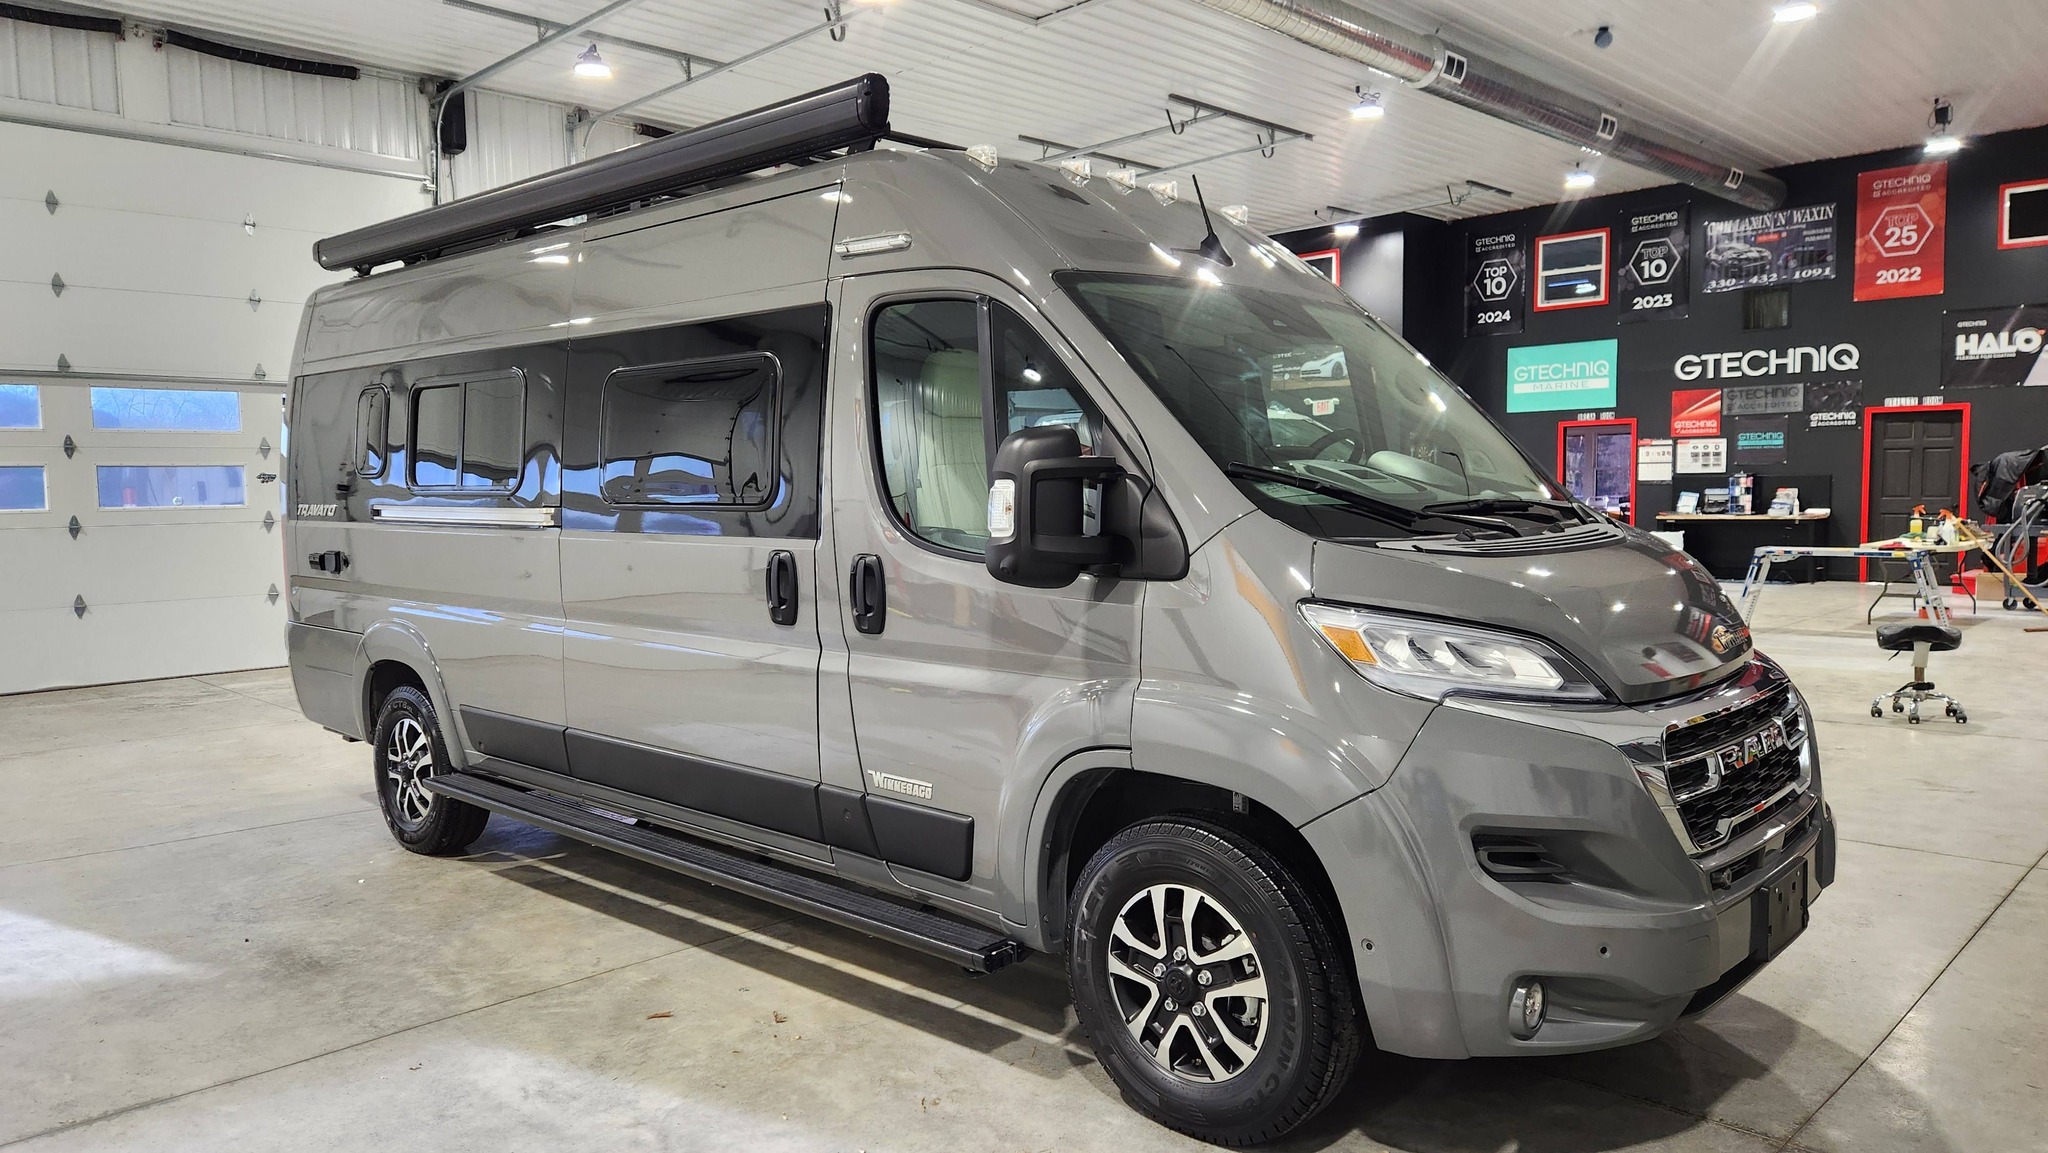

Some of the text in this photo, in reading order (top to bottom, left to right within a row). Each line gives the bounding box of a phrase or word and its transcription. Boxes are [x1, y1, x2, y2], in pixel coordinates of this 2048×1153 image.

[1873, 173, 1931, 190] GTECHNIQ
[1631, 210, 1678, 226] GTECHNIQ
[1793, 203, 1836, 223] WAXIN
[1885, 213, 1919, 228] TOP
[1475, 233, 1516, 247] GTECHNIQ
[1884, 225, 1918, 249] 25
[1481, 242, 1516, 252] ACCREDITED
[1641, 246, 1669, 260] TOP
[1484, 266, 1507, 279] TOP
[1640, 259, 1668, 280] 10
[1876, 266, 1922, 286] 2022
[1707, 277, 1736, 290] 330
[1749, 272, 1778, 285] 432
[1792, 266, 1831, 280] 1091
[1484, 277, 1507, 297] 10
[1632, 293, 1673, 310] 2023
[1477, 310, 1512, 324] 2024
[1955, 327, 2042, 356] HALO
[1673, 342, 1860, 382] GTECHNIQ
[1513, 360, 1610, 382] GTECHNIQ
[1532, 380, 1590, 391] MARINE
[1726, 386, 1800, 401] GTECHNIQ
[1737, 400, 1799, 411] ACCREDITED
[1674, 419, 1718, 429] GTECHNIQ
[1810, 411, 1857, 421] GTECHNIQ
[1738, 431, 1785, 441] GTECHNIQ
[297, 504, 338, 517] TRAVATO
[1716, 720, 1785, 777] RAM
[867, 769, 933, 800] WINNEBAGO
